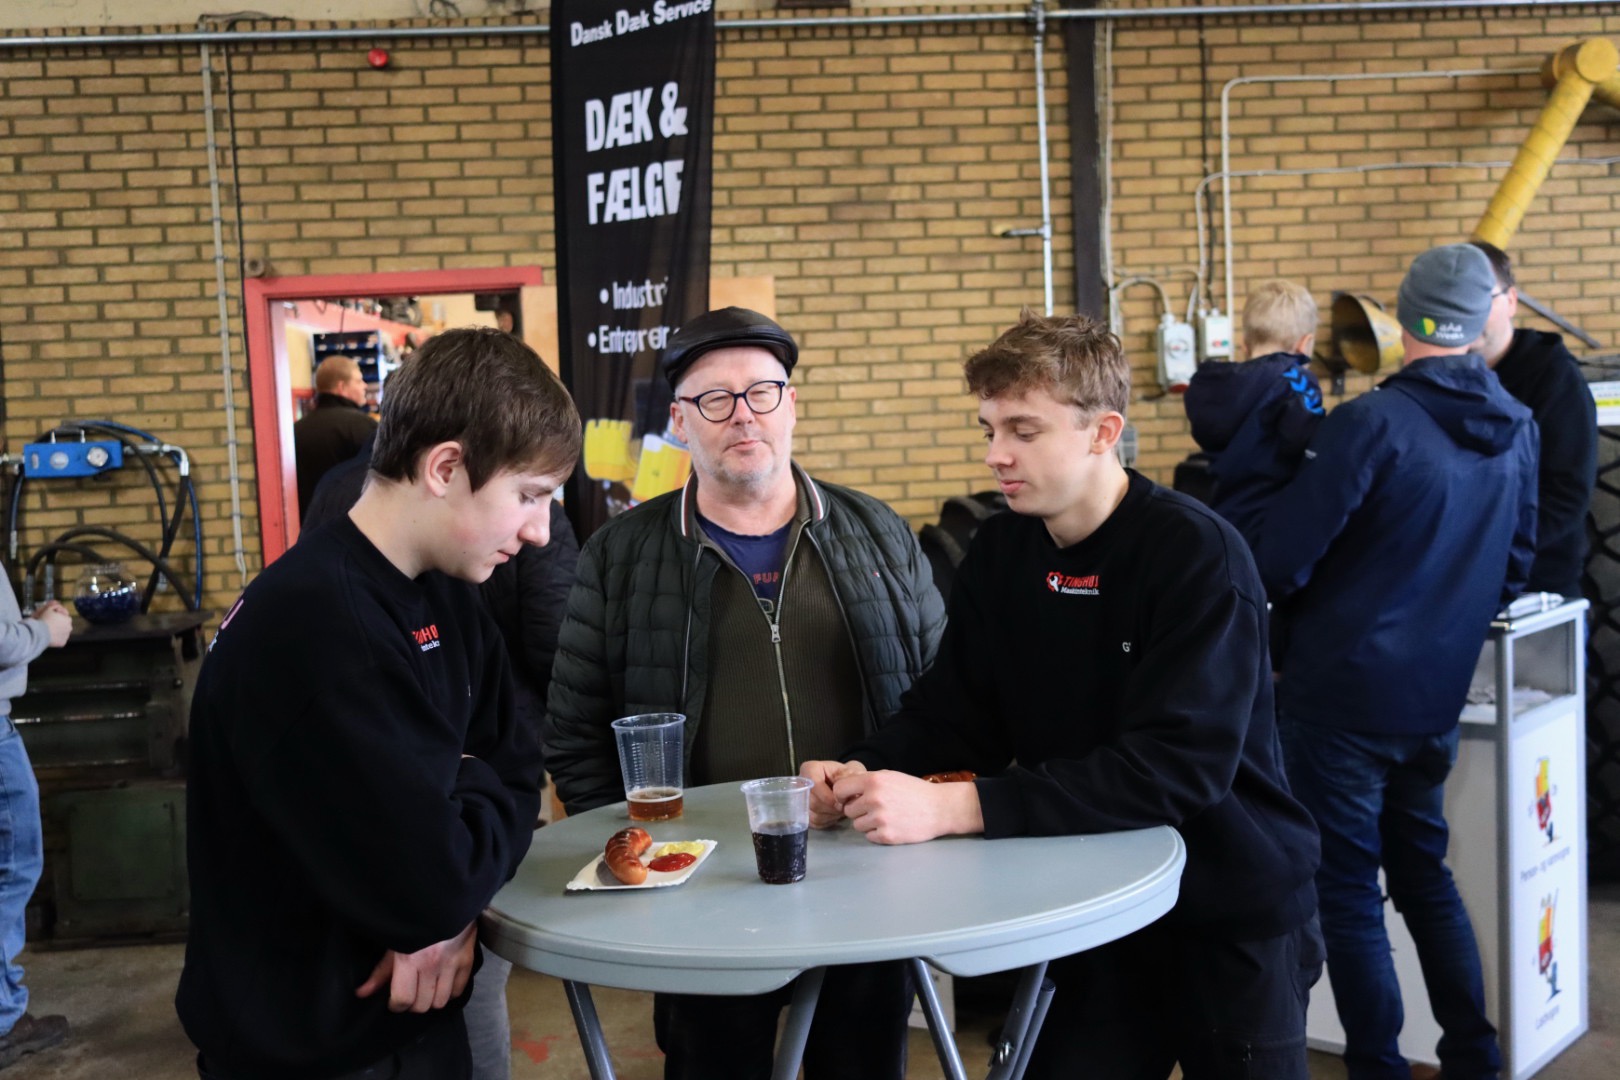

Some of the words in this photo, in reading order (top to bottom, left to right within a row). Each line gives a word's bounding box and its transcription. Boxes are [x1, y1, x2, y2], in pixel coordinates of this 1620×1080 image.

[570, 20, 613, 47] Dansk
[615, 9, 650, 36] Dæk
[653, 0, 712, 25] Service
[585, 87, 654, 152] DÆK
[659, 81, 689, 139] &
